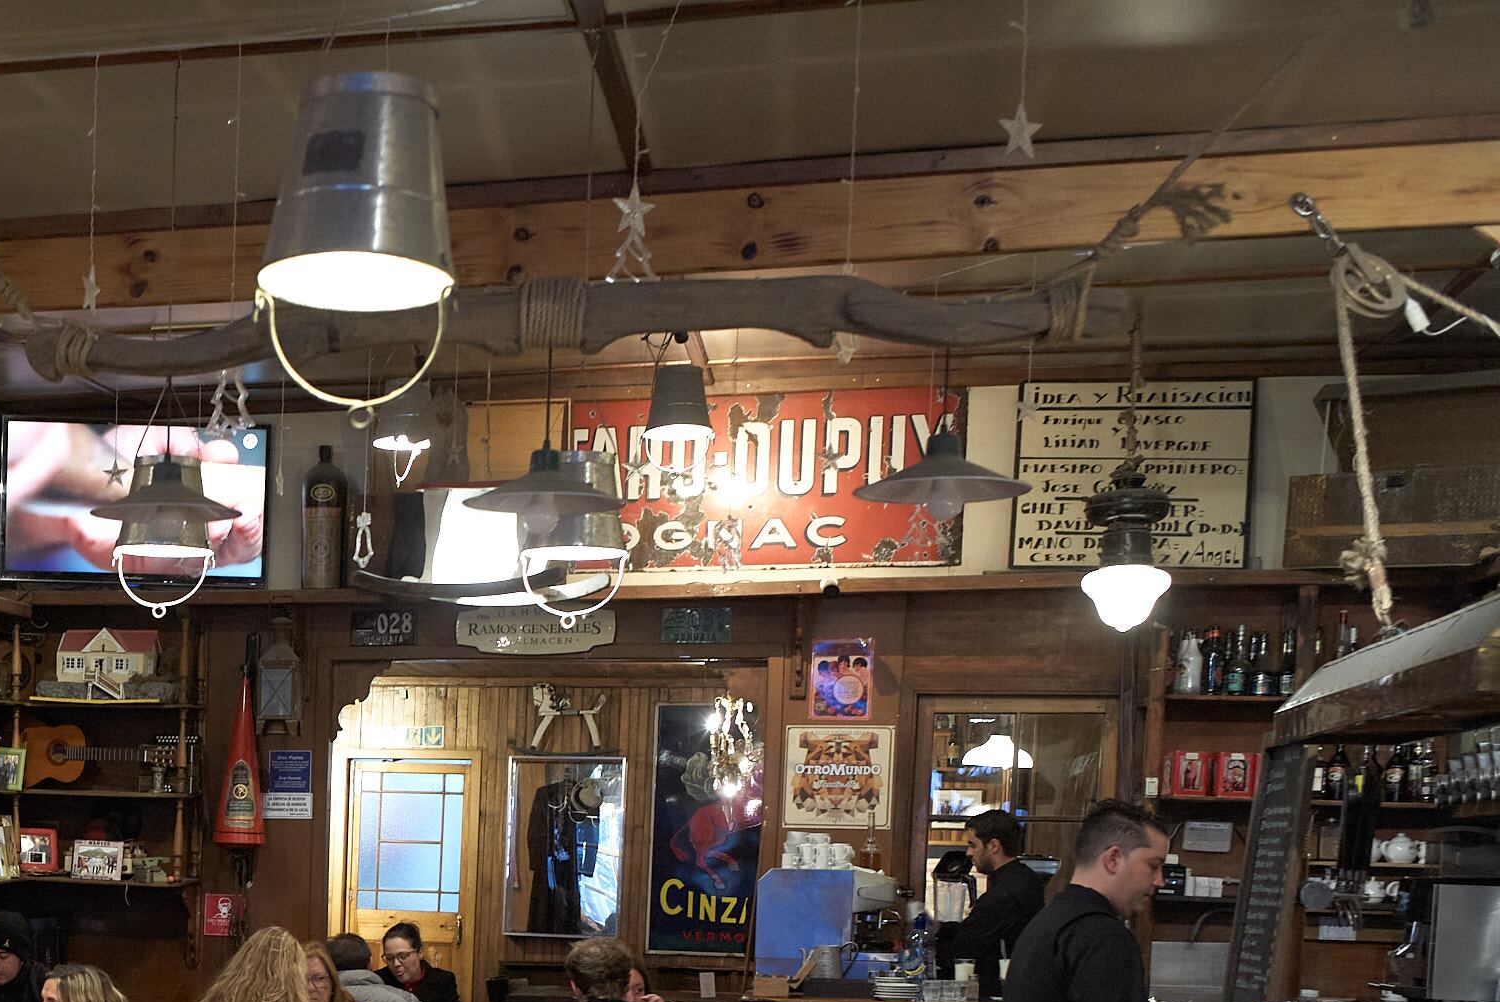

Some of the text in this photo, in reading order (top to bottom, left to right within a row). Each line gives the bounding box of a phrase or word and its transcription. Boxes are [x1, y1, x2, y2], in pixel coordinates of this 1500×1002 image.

[1022, 464, 1103, 474] MAESTRO
[1018, 537, 1072, 549] MANO
[1030, 552, 1086, 562] CESAR
[377, 612, 413, 634] 028
[467, 622, 517, 636] RAMOS
